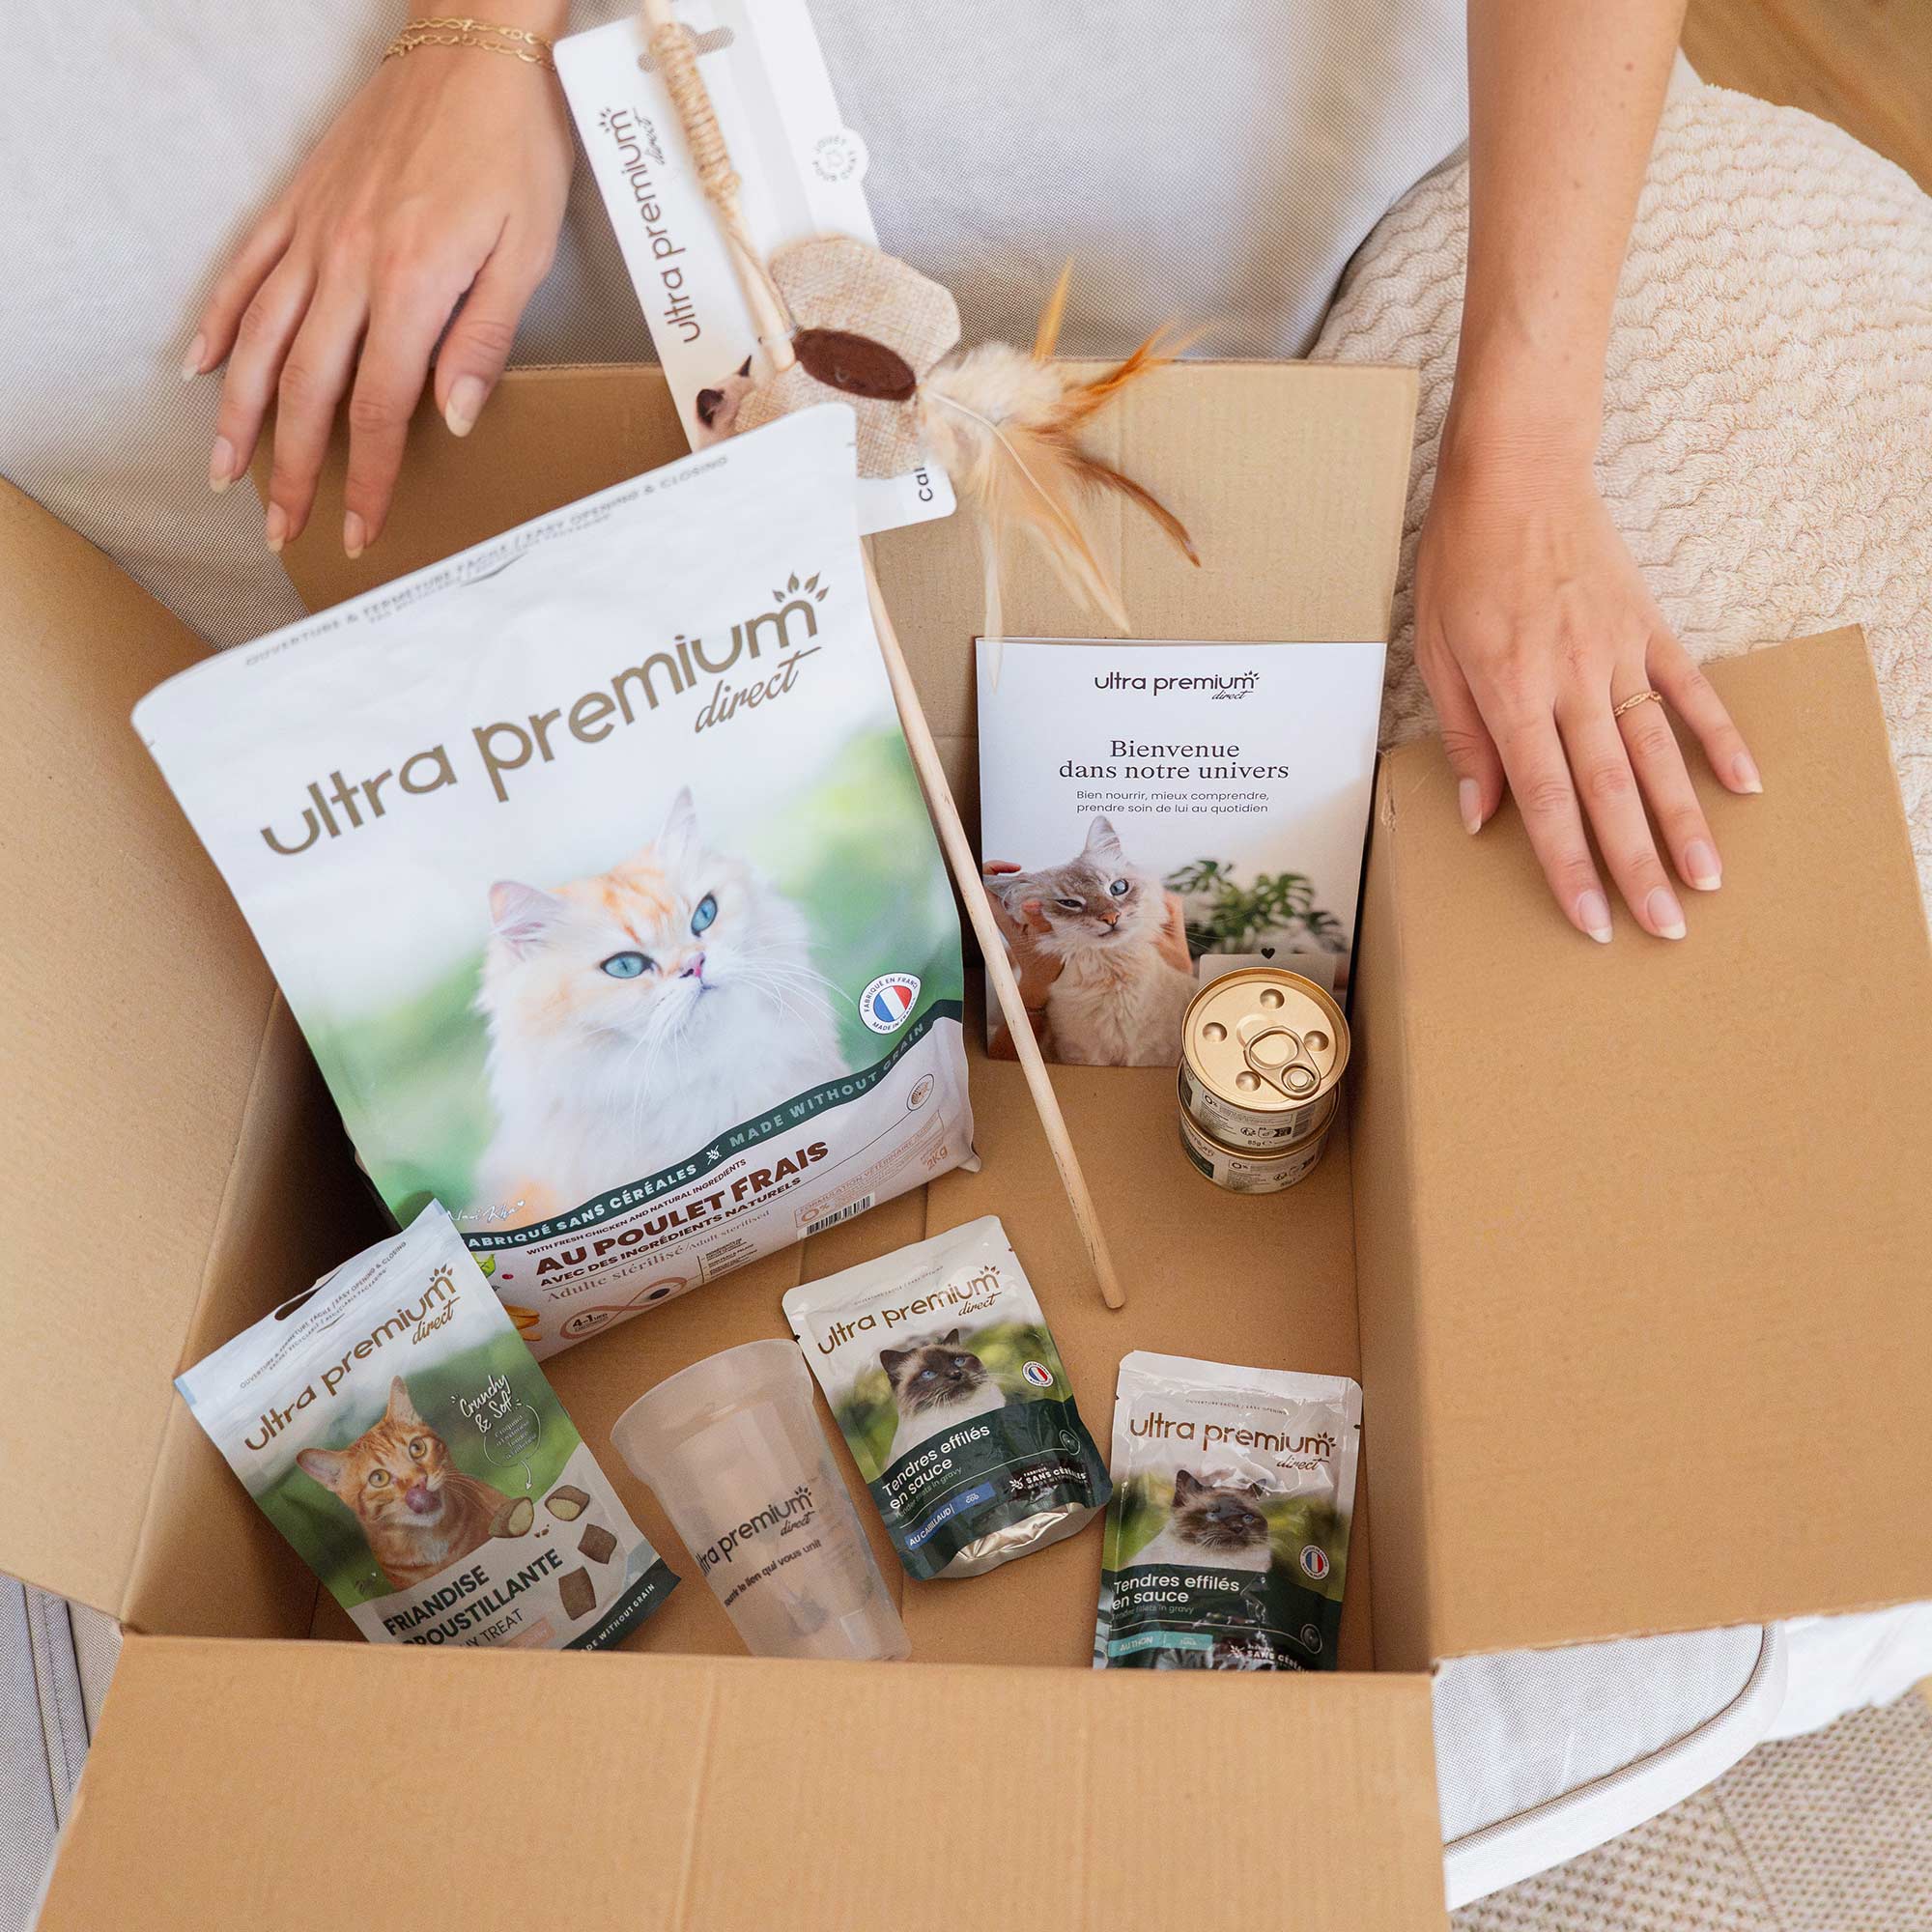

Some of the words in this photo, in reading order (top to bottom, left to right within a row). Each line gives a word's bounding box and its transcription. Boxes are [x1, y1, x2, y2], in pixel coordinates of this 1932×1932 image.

[610, 110, 686, 260] premium
[661, 268, 701, 343] ultra
[694, 645, 823, 734] direct
[1094, 671, 1147, 691] ultra
[1153, 673, 1255, 696] premium
[1211, 689, 1255, 700] direct
[259, 743, 459, 856] ultra
[471, 591, 821, 804] premium
[1059, 759, 1118, 780] dans
[1124, 763, 1190, 780] notre
[1198, 761, 1290, 780] univers
[1109, 739, 1240, 758] Bienvenue
[1076, 790, 1103, 801] Bien
[1105, 790, 1149, 802] nourrir,
[1151, 790, 1188, 801] mieux
[1190, 791, 1270, 803] comprendre,
[1076, 804, 1125, 814] prendre
[1127, 804, 1152, 813] soin
[1155, 804, 1172, 813] de
[1175, 804, 1189, 813] lui
[1210, 804, 1269, 814] quotidien
[463, 1225, 552, 1249] ABRIQUÉ
[555, 1204, 606, 1231] SANS
[609, 1163, 697, 1209] CÉRÉALES
[728, 1115, 785, 1148] MADE
[788, 1071, 879, 1119] WITHOUT
[882, 1022, 925, 1071] GRAIN
[526, 1244, 554, 1256] WITH
[554, 1234, 584, 1249] FRESH
[584, 1217, 629, 1239] CHICKEN
[629, 1209, 650, 1223] AND
[649, 1190, 694, 1215] NATURAL
[691, 1157, 748, 1195] INGREDIENTS
[535, 1246, 588, 1277] AU
[594, 1191, 726, 1257] POULET
[729, 1140, 830, 1204] FRAIS
[540, 1267, 585, 1288] AVEC
[587, 1257, 619, 1273] DES
[619, 1212, 724, 1263] INGRÉDIENTS
[724, 1176, 802, 1219] NATURELS
[547, 1274, 608, 1303] Adulte
[957, 1292, 1002, 1317] direct
[412, 1296, 462, 1346] direct
[817, 1314, 877, 1355] ultra
[881, 1271, 1001, 1329] premium
[243, 1384, 318, 1451] ultra
[320, 1273, 458, 1397] premium
[459, 1375, 511, 1418] Crunchy
[474, 1413, 492, 1434] &
[488, 1390, 513, 1419] Soft
[1129, 1411, 1195, 1440] ultra
[1203, 1423, 1331, 1458] premium
[881, 1450, 939, 1497] Tendres
[940, 1424, 991, 1455] effilés
[939, 1465, 963, 1486] gravy
[1025, 1471, 1053, 1484] SANS
[1276, 1453, 1330, 1471] direct
[889, 1493, 909, 1510] en
[908, 1456, 953, 1496] sauce
[717, 1491, 813, 1563] premium
[780, 1510, 815, 1537] direct
[909, 1534, 922, 1547] AU
[920, 1507, 952, 1540] CABILLAUD
[761, 1560, 778, 1577] qui
[778, 1548, 803, 1566] vous
[1113, 1573, 1180, 1595] Tendres
[1184, 1575, 1240, 1592] effilés
[383, 1564, 490, 1636] FRIANDISE
[403, 1548, 564, 1646] ROUSTILLANTE
[598, 1605, 635, 1640] WITHOUT
[632, 1582, 656, 1607] GRAIN
[1112, 1595, 1130, 1610] en
[1133, 1590, 1189, 1605] sauce
[1169, 1605, 1195, 1616] gravy
[480, 1607, 524, 1641] TREAT
